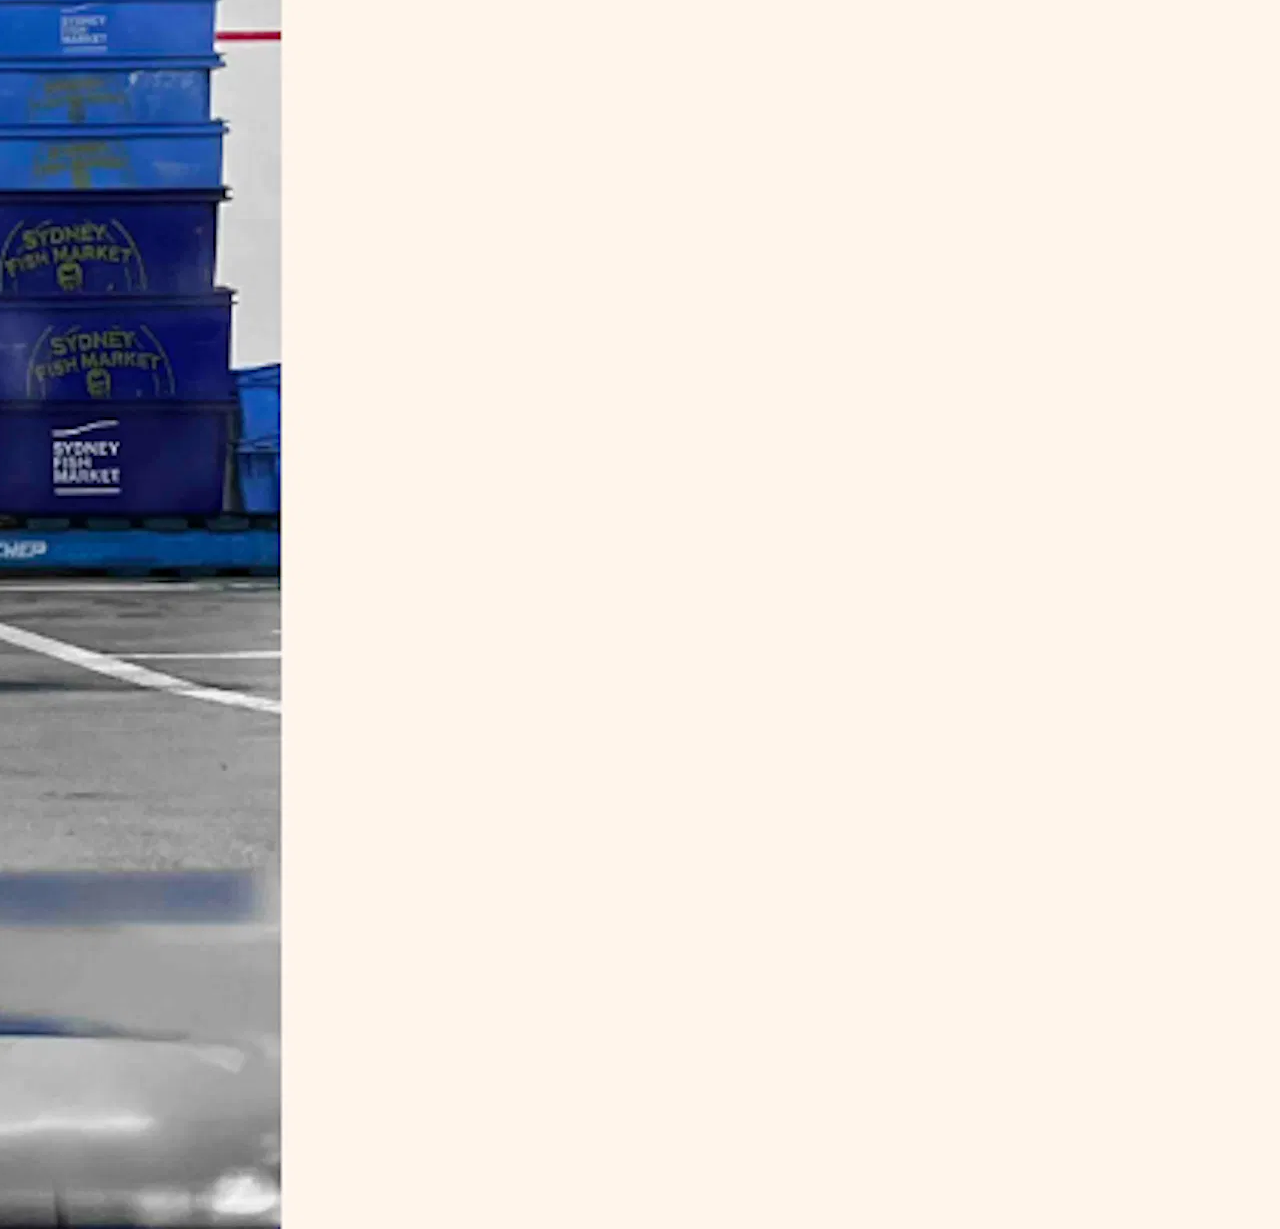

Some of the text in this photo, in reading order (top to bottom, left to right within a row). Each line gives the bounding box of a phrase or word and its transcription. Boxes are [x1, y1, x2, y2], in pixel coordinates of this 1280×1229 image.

[22, 223, 108, 250] SYDNEY
[52, 245, 133, 264] MARKET
[51, 330, 136, 355] SYDNEY
[34, 350, 161, 382] FISH MARKET
[52, 440, 121, 457] SYDNEY
[52, 456, 93, 469] FISH
[52, 468, 121, 484] MARKET
